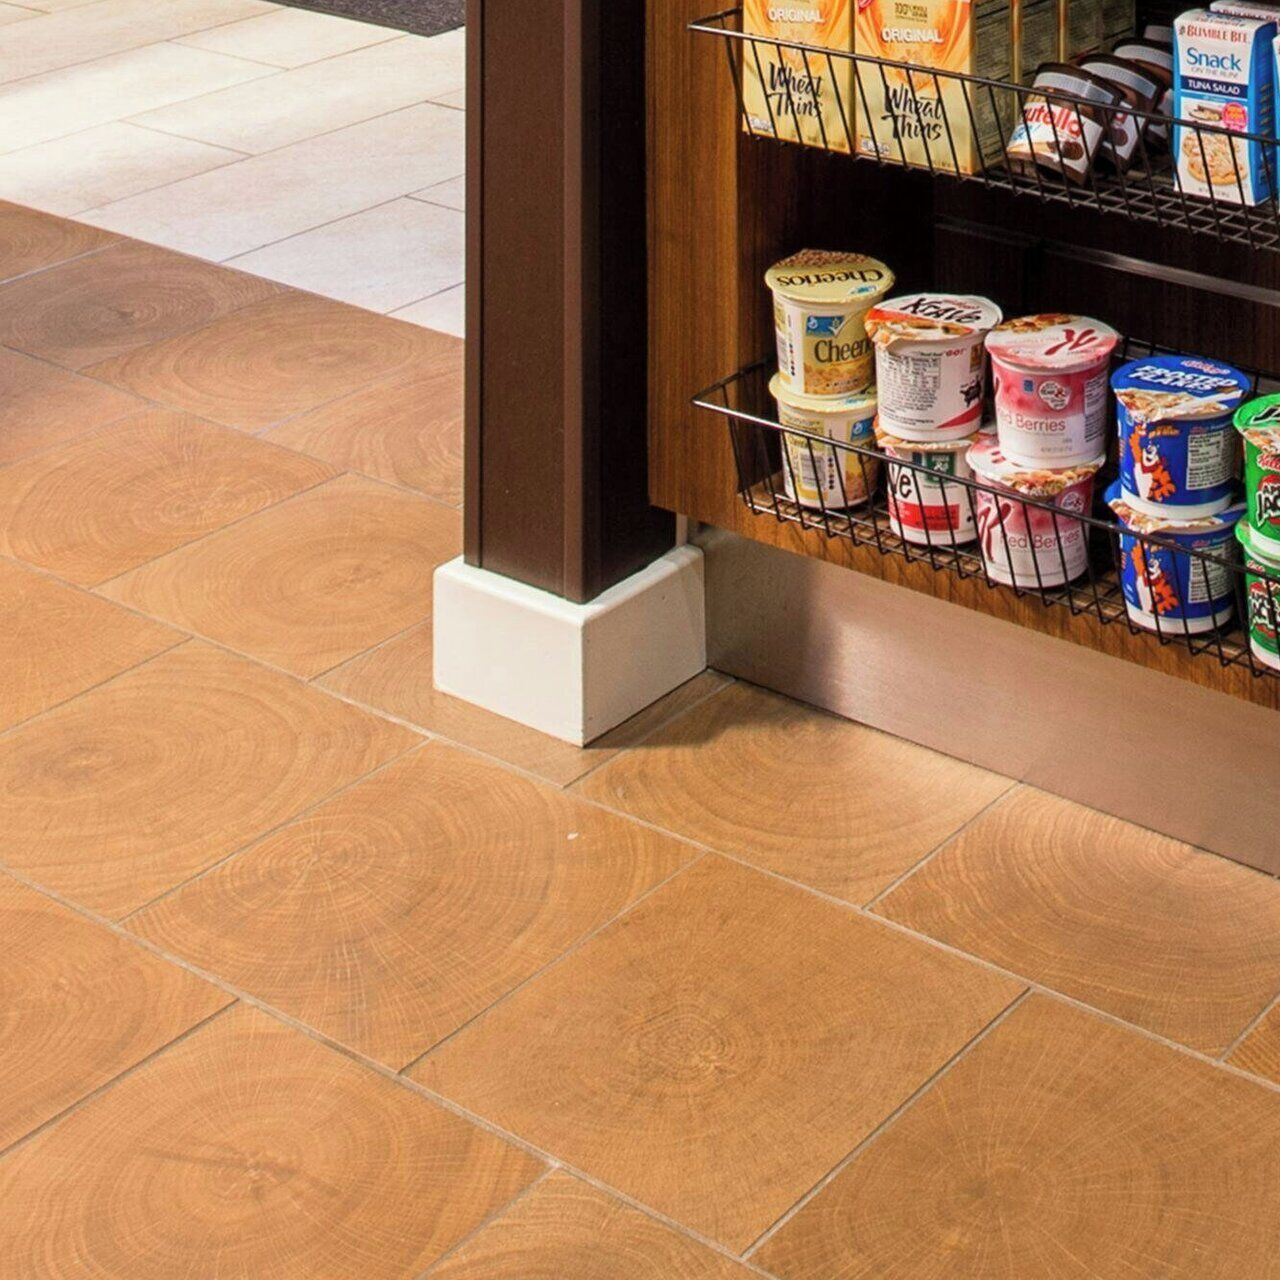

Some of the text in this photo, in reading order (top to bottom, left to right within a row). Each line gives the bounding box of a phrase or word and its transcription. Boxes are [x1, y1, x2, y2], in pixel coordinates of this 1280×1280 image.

[768, 8, 825, 24] ORIGINAL
[881, 27, 944, 44] ORIGINAL
[1187, 24, 1248, 43] BUMBLE BEE
[1186, 46, 1242, 72] Snack
[768, 61, 823, 97] Wheat
[1188, 80, 1241, 96] TUNA SALAD
[776, 268, 885, 288] Cheerios
[1017, 414, 1067, 433] Berries
